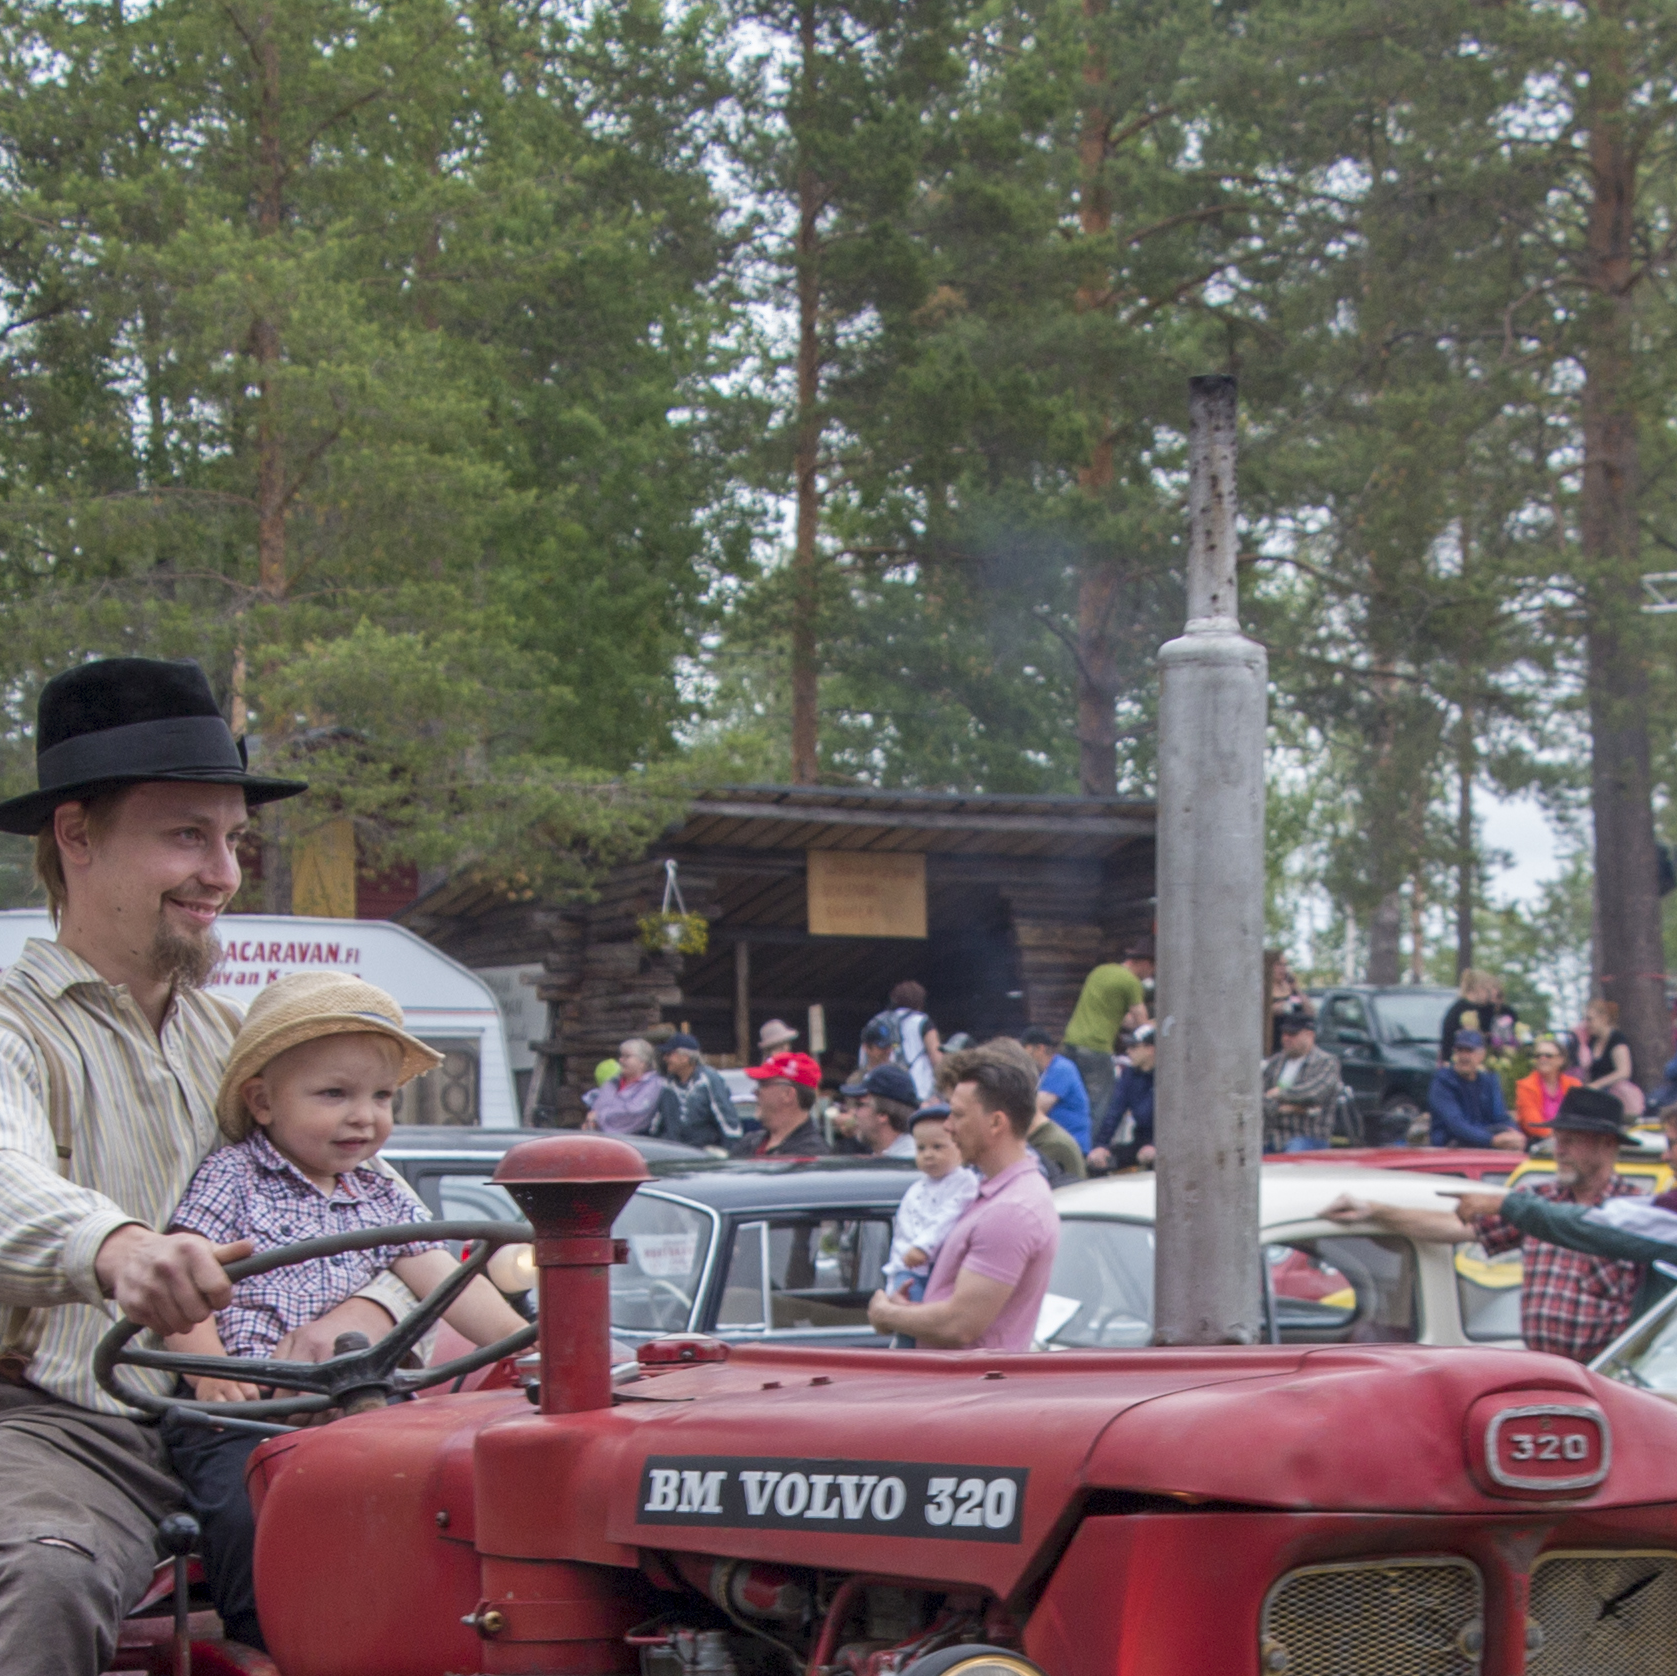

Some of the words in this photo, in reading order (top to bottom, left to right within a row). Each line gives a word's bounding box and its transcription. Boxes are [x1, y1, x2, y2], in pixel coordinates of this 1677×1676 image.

[225, 940, 360, 964] ACARAVAN.FI
[210, 971, 260, 986] avan
[1509, 1434, 1589, 1460] 320
[644, 1469, 728, 1514] BM
[738, 1471, 908, 1521] VOLVO
[924, 1477, 1018, 1530] 320
